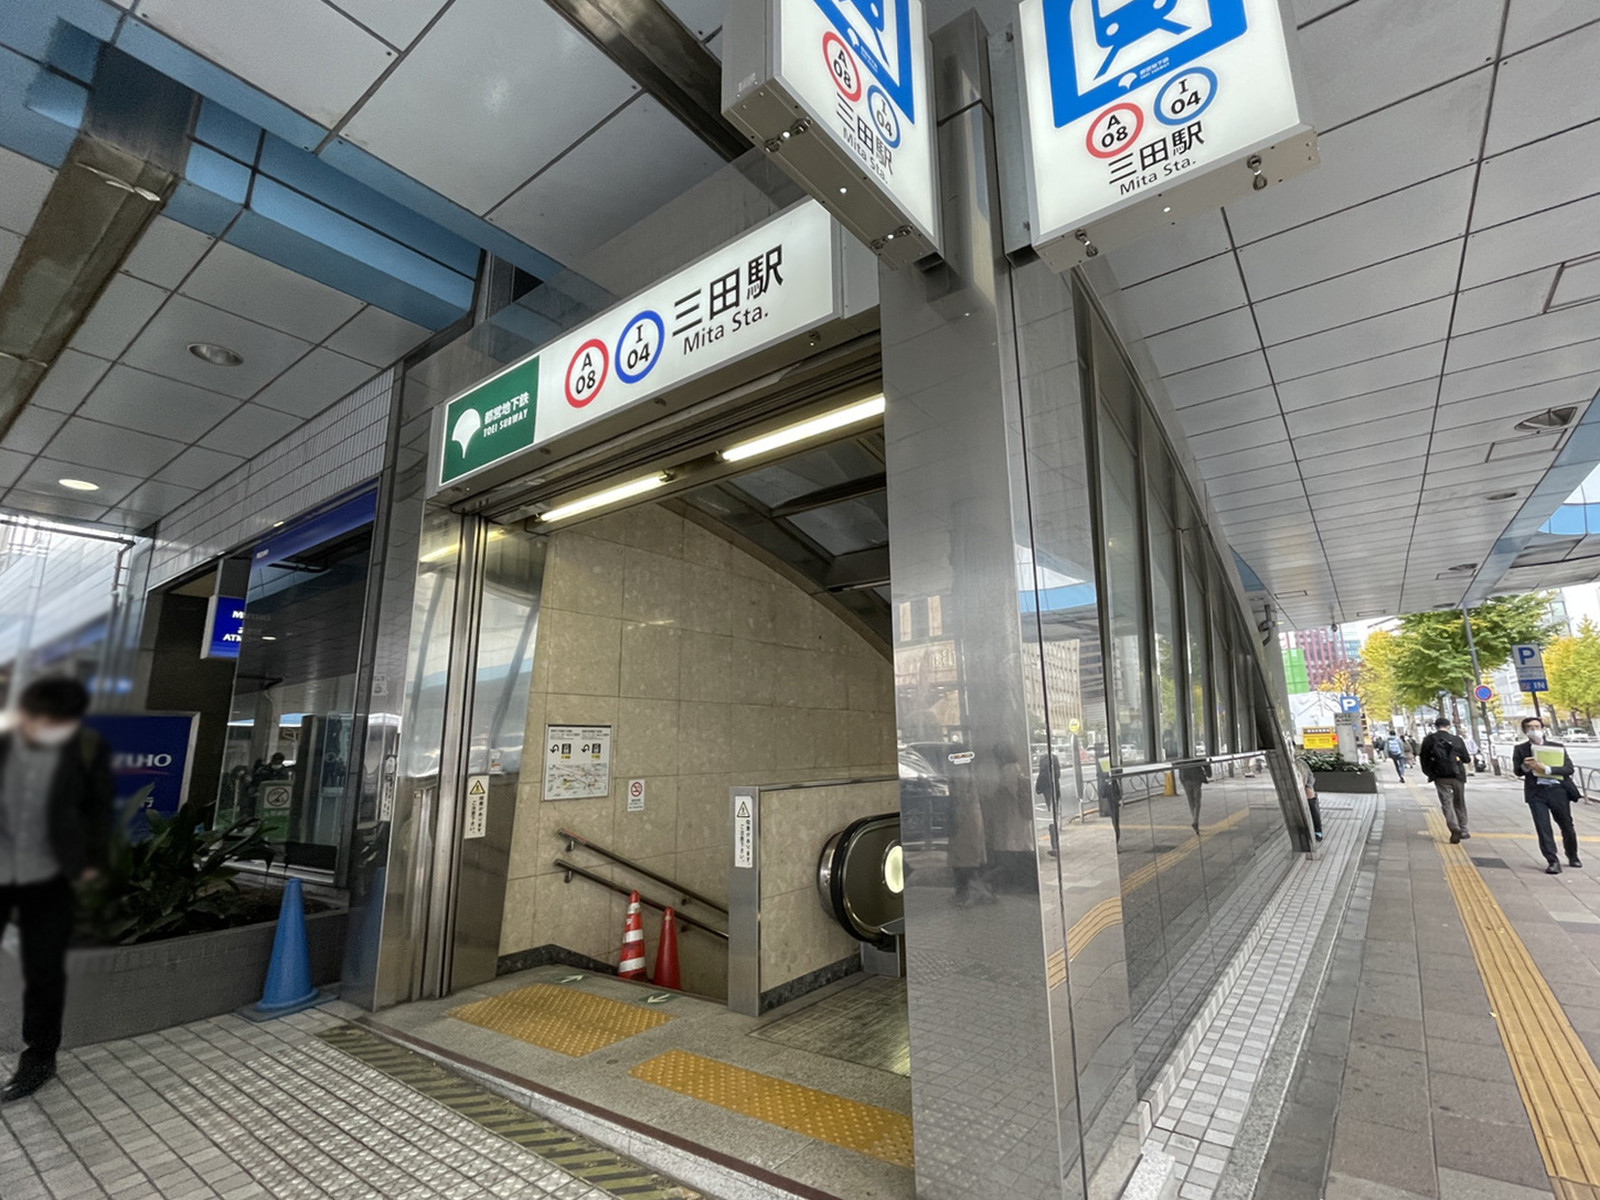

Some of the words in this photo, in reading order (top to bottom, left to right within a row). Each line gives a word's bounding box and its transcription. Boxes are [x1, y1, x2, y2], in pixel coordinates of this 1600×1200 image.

[838, 50, 848, 69] A
[833, 59, 852, 89] 08
[1178, 78, 1189, 95] I
[881, 99, 887, 116] I
[1171, 90, 1201, 115] 04
[836, 92, 894, 176] 三田駅
[876, 110, 893, 138] 04
[1107, 114, 1121, 130] A
[1101, 126, 1128, 148] 08
[843, 127, 867, 161] Mita
[870, 157, 888, 184] Sta.
[1108, 120, 1205, 184] 三田駅
[1119, 172, 1157, 195] Mita
[1163, 157, 1196, 177] Sta.
[672, 244, 783, 337] 三田駅
[635, 324, 643, 344] I
[683, 324, 724, 355] Mita
[732, 306, 768, 332] Sta.
[581, 352, 592, 371] A
[627, 341, 650, 370] 04
[575, 369, 596, 394] 08
[484, 391, 529, 425] 都営地下鉄
[483, 423, 498, 438] TOEI
[499, 408, 528, 430] SUBWAY
[1518, 647, 1535, 665] P
[1342, 699, 1356, 711] P
